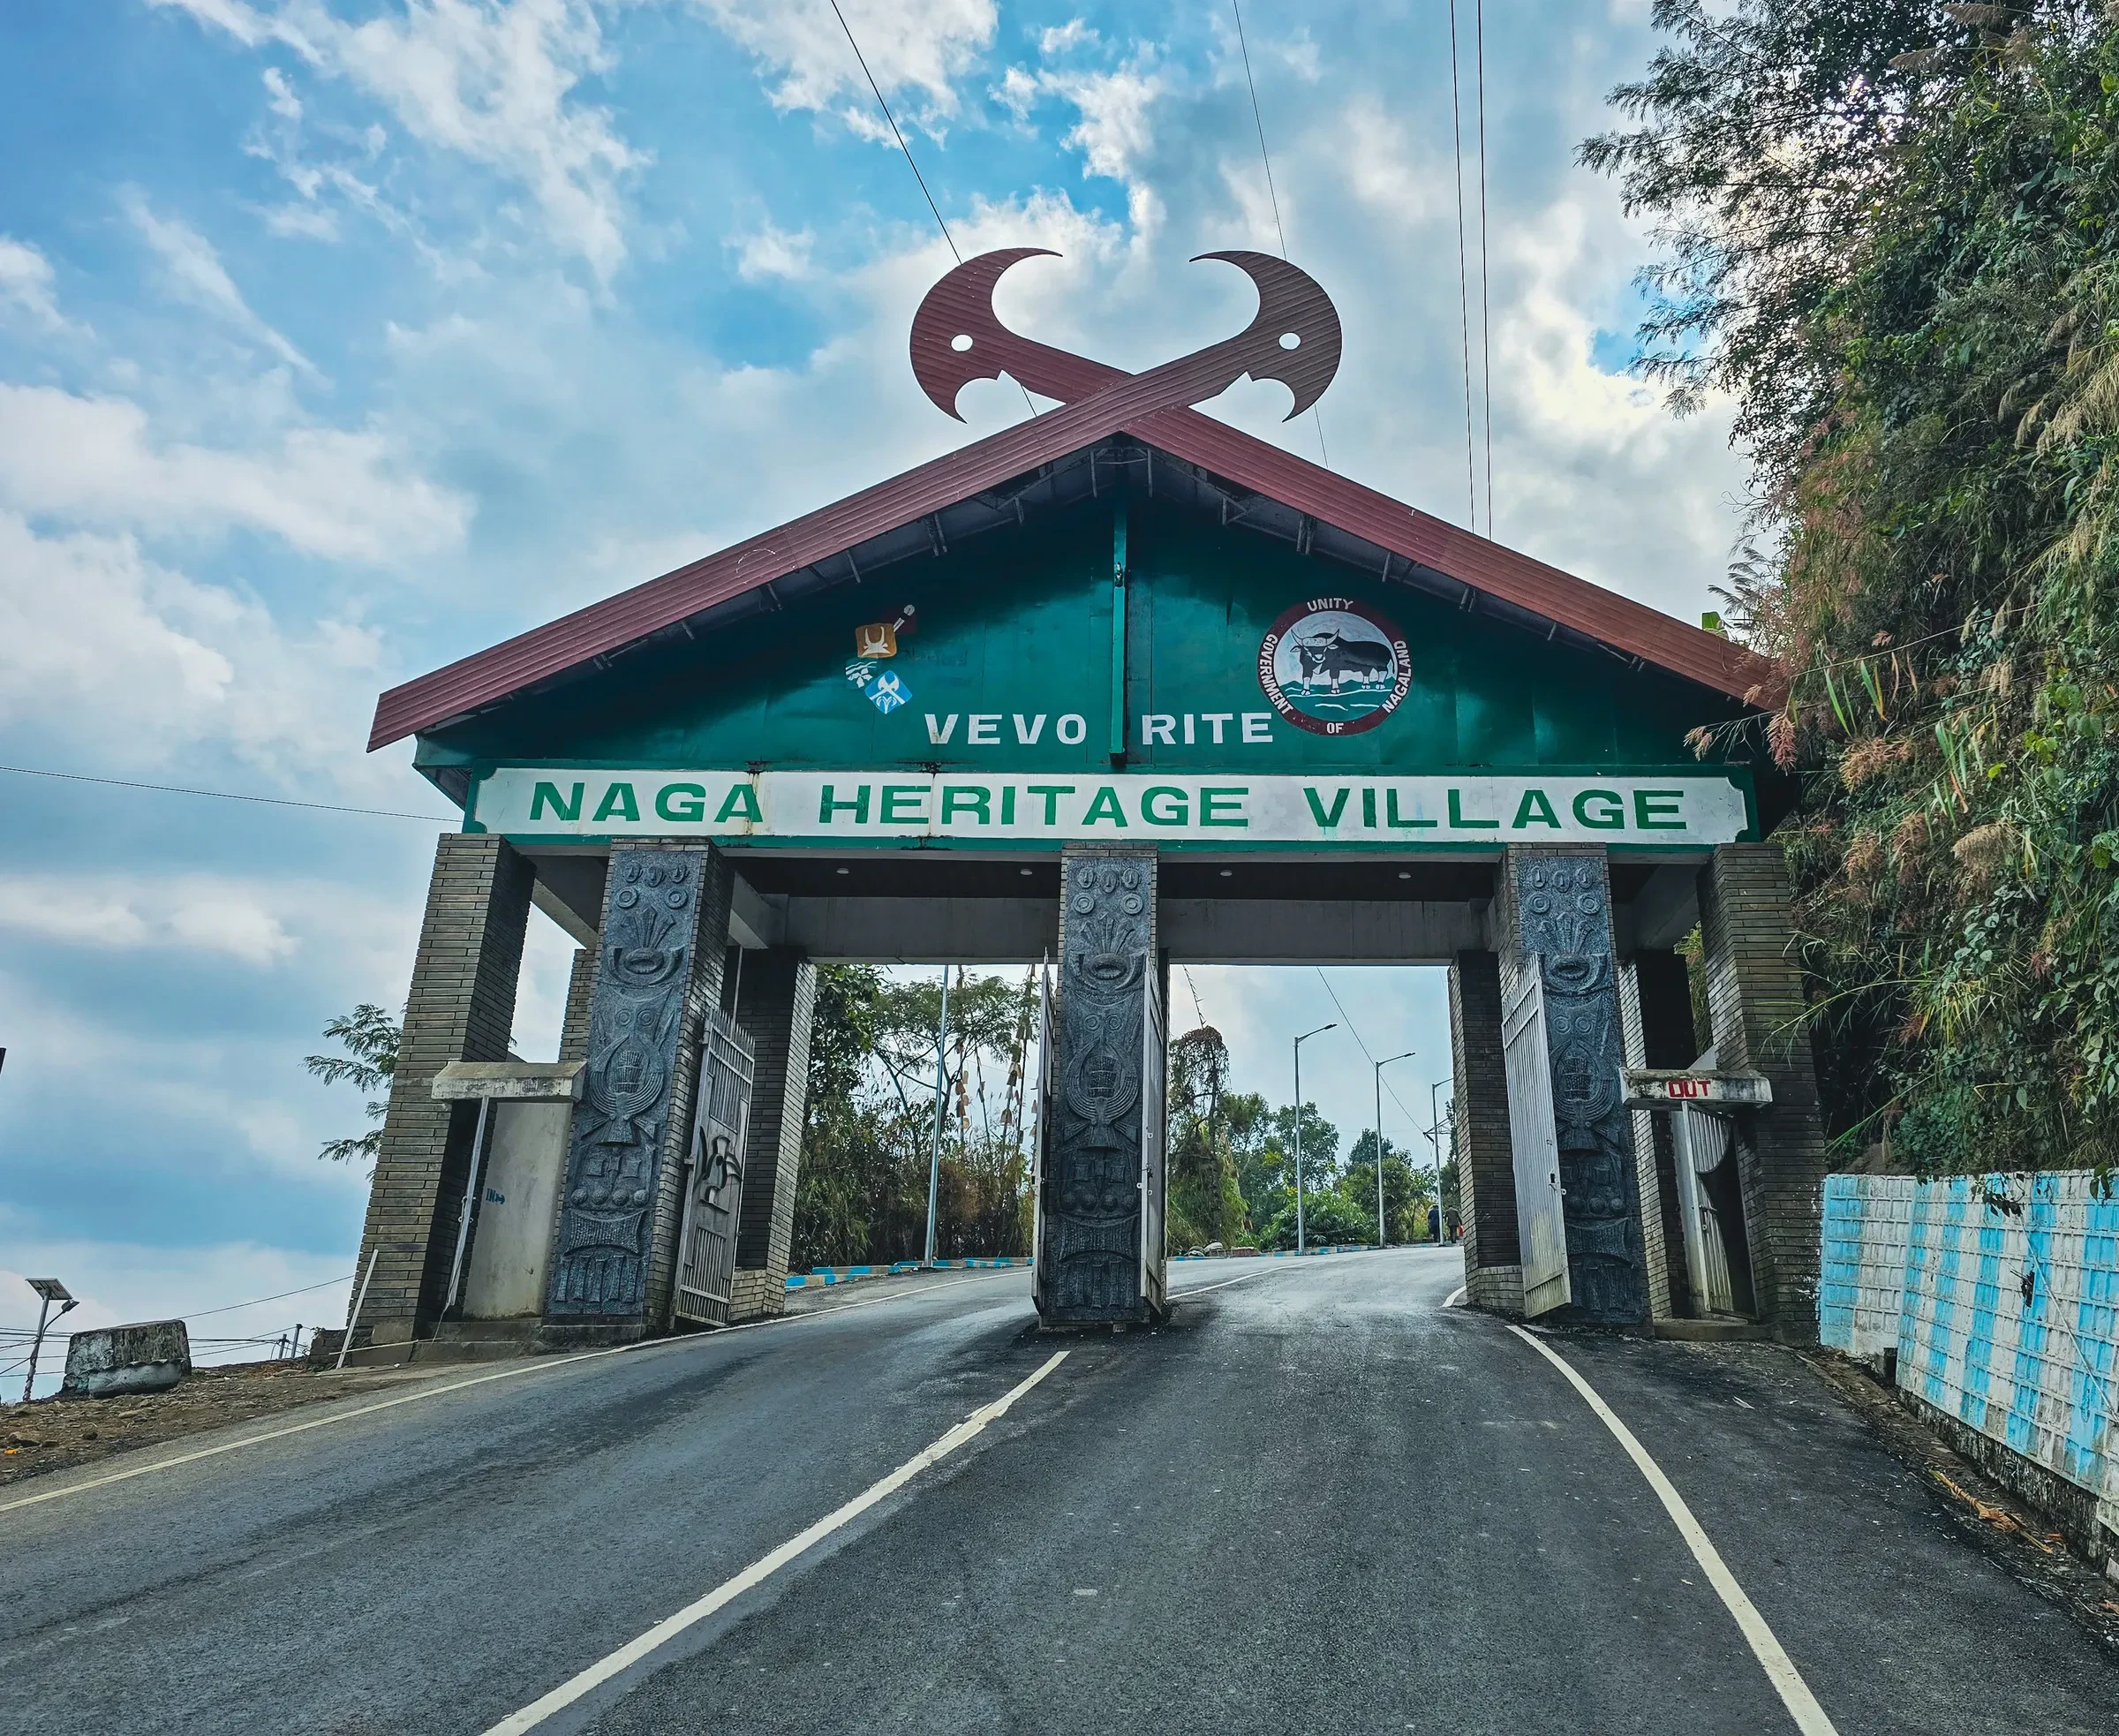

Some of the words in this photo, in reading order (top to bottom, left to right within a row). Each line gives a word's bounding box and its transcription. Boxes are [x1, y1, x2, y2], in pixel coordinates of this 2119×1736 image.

[1307, 597, 1354, 612] UNITY
[1260, 633, 1294, 714] GOVERNMENT
[1326, 722, 1345, 734] OF
[1381, 640, 1412, 713] NAGALAND
[924, 713, 1087, 744] VEVO
[1142, 713, 1273, 743] RITE
[530, 781, 764, 822] NAGA
[818, 784, 1249, 827] HERITAGE
[1302, 787, 1687, 830] VILLAGE
[1668, 1080, 1711, 1098] OUT
